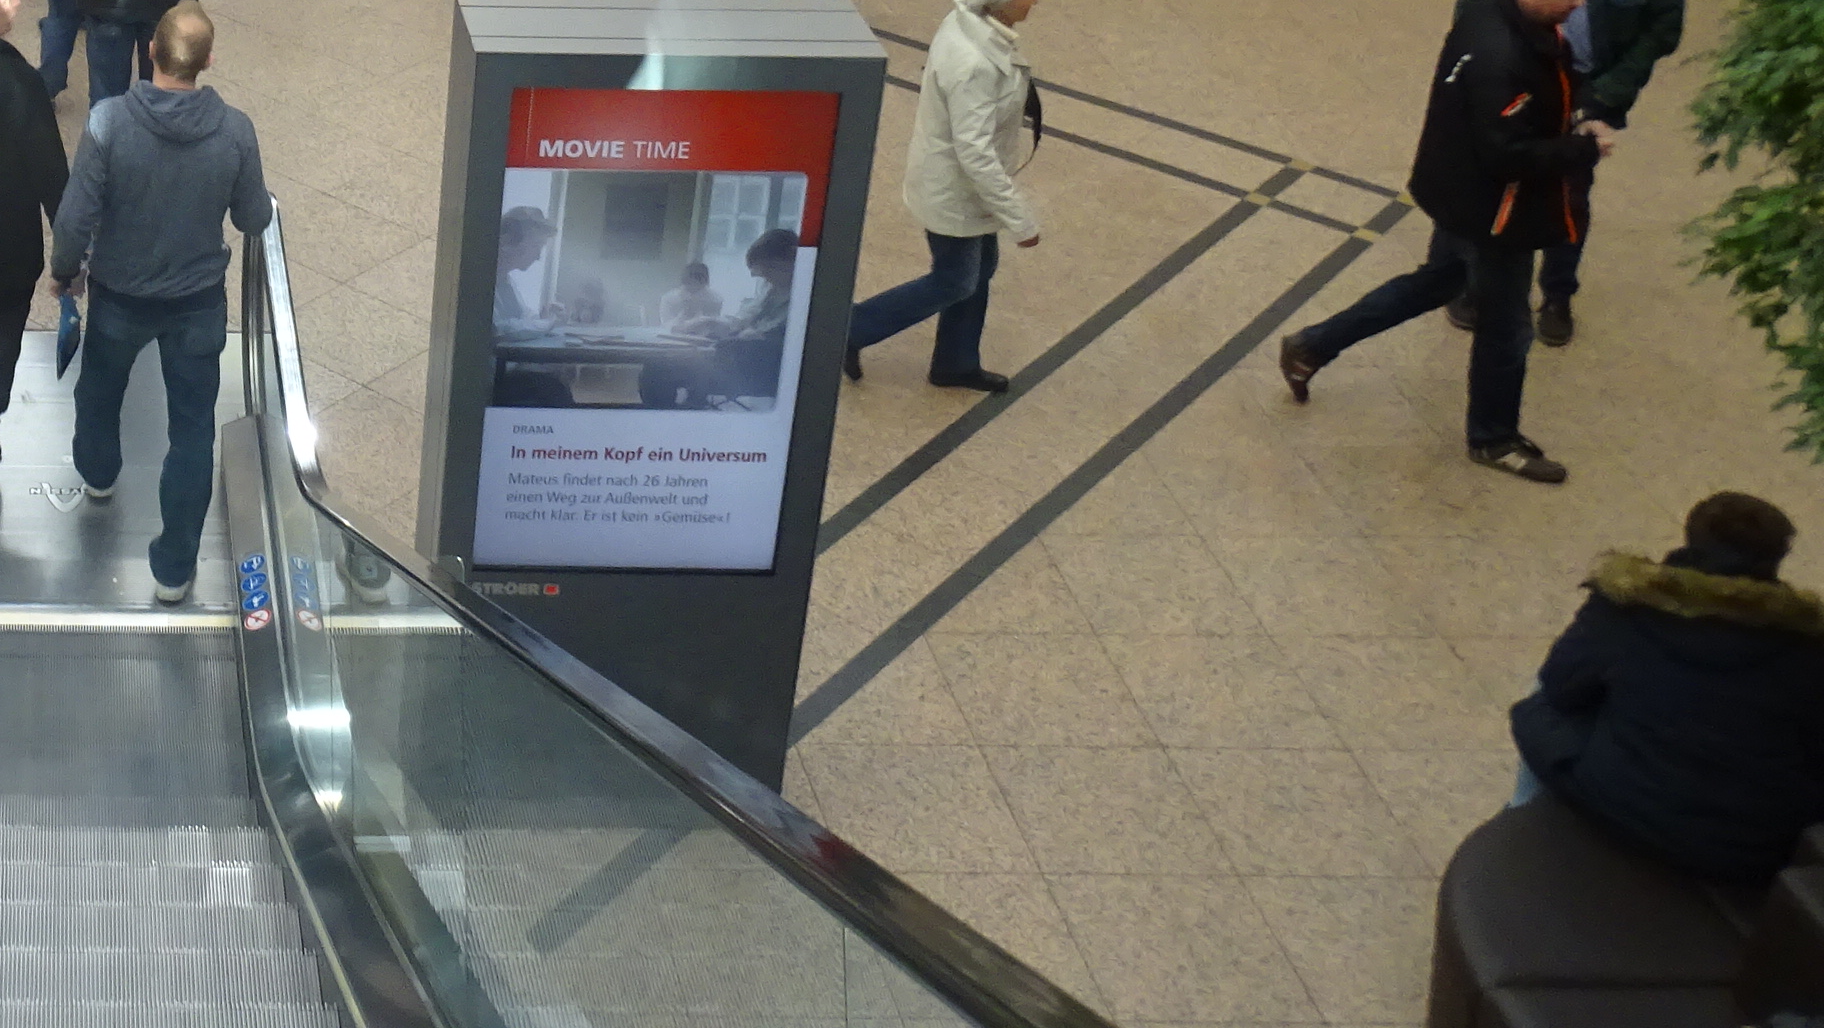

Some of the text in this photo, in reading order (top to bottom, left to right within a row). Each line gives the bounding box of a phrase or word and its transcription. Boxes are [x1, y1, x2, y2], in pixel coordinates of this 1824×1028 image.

[538, 139, 691, 160] MOVIE TIME
[512, 424, 555, 435] DRAMA
[511, 445, 767, 465] In meinem Kopf ein Universum
[508, 472, 709, 488] Mateus findet nach 26 Jahren
[506, 491, 709, 507] einen Weg zur Außenwelt und
[583, 510, 596, 522] Er
